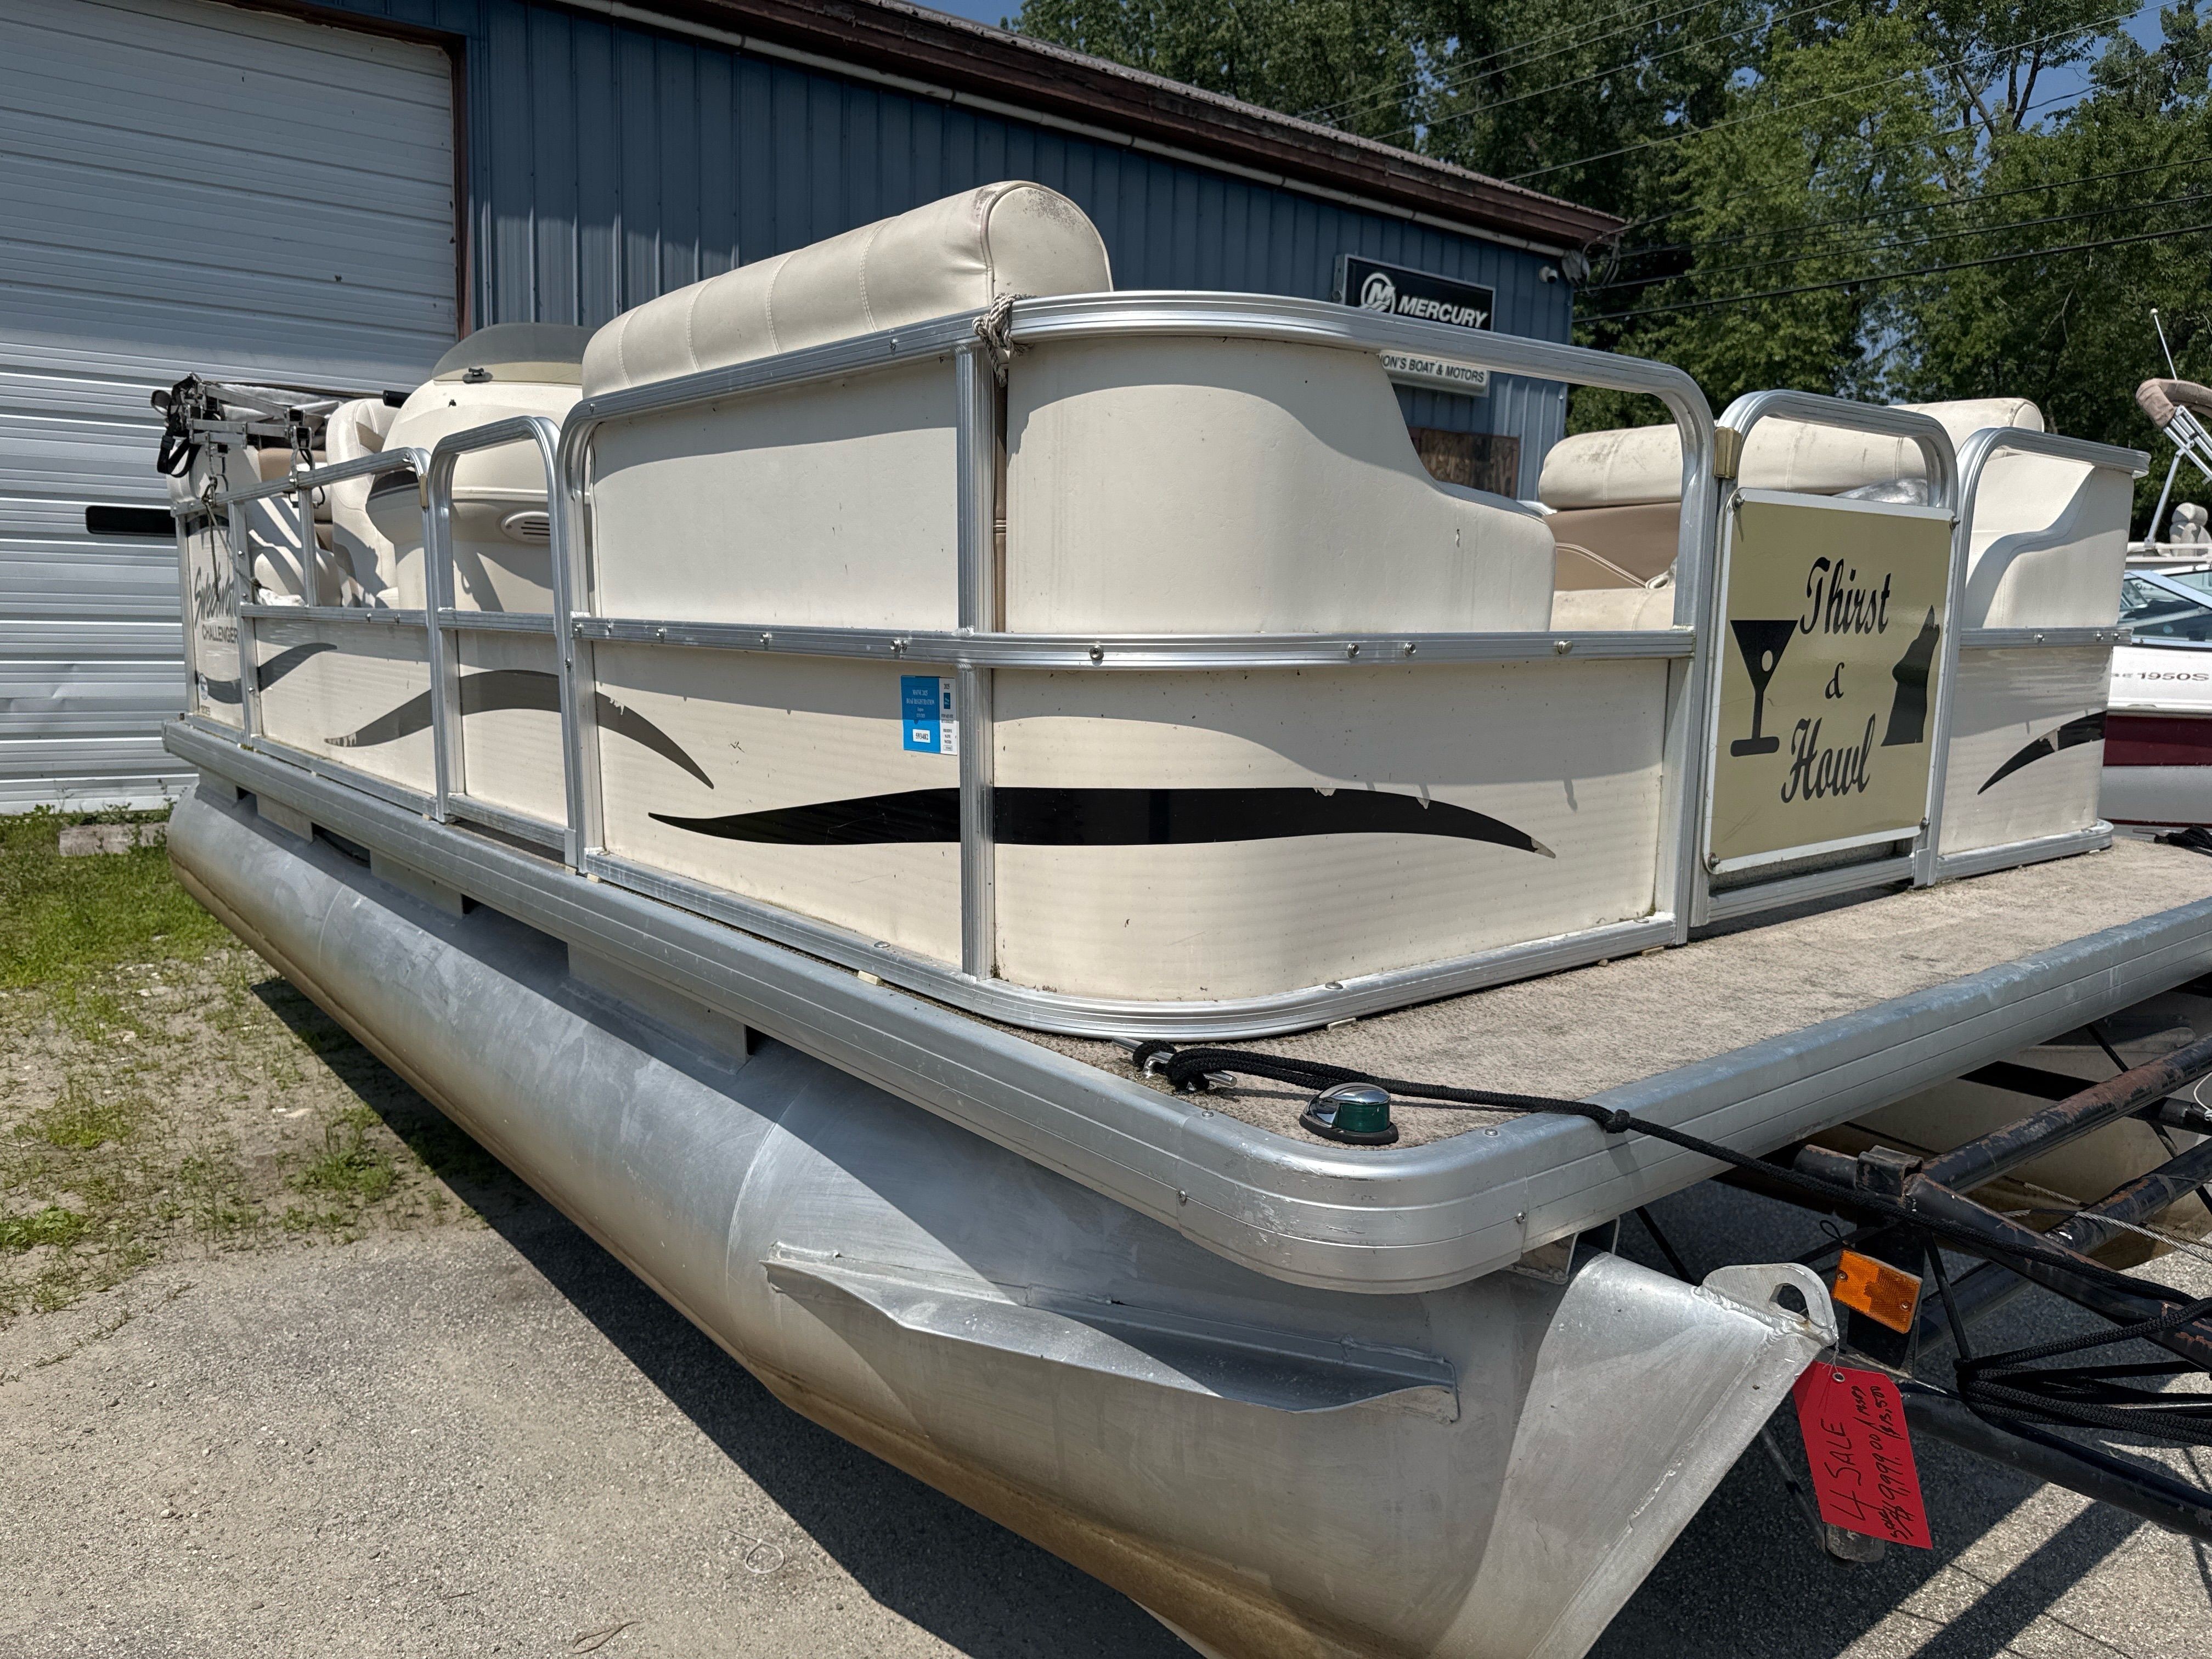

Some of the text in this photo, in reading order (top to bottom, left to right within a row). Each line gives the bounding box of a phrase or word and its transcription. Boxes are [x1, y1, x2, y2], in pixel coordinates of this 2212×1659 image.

[1398, 295, 1488, 328] MERCURY
[1408, 359, 1435, 374] BOAT
[1436, 364, 1442, 375] &
[1445, 366, 1485, 383] MOTORS
[1800, 557, 1892, 635] Thirst
[201, 624, 238, 644] CHALLENGER
[1825, 662, 1845, 699] &
[1781, 713, 1876, 803] Howl
[1820, 1418, 1883, 1521] 4 SALE
